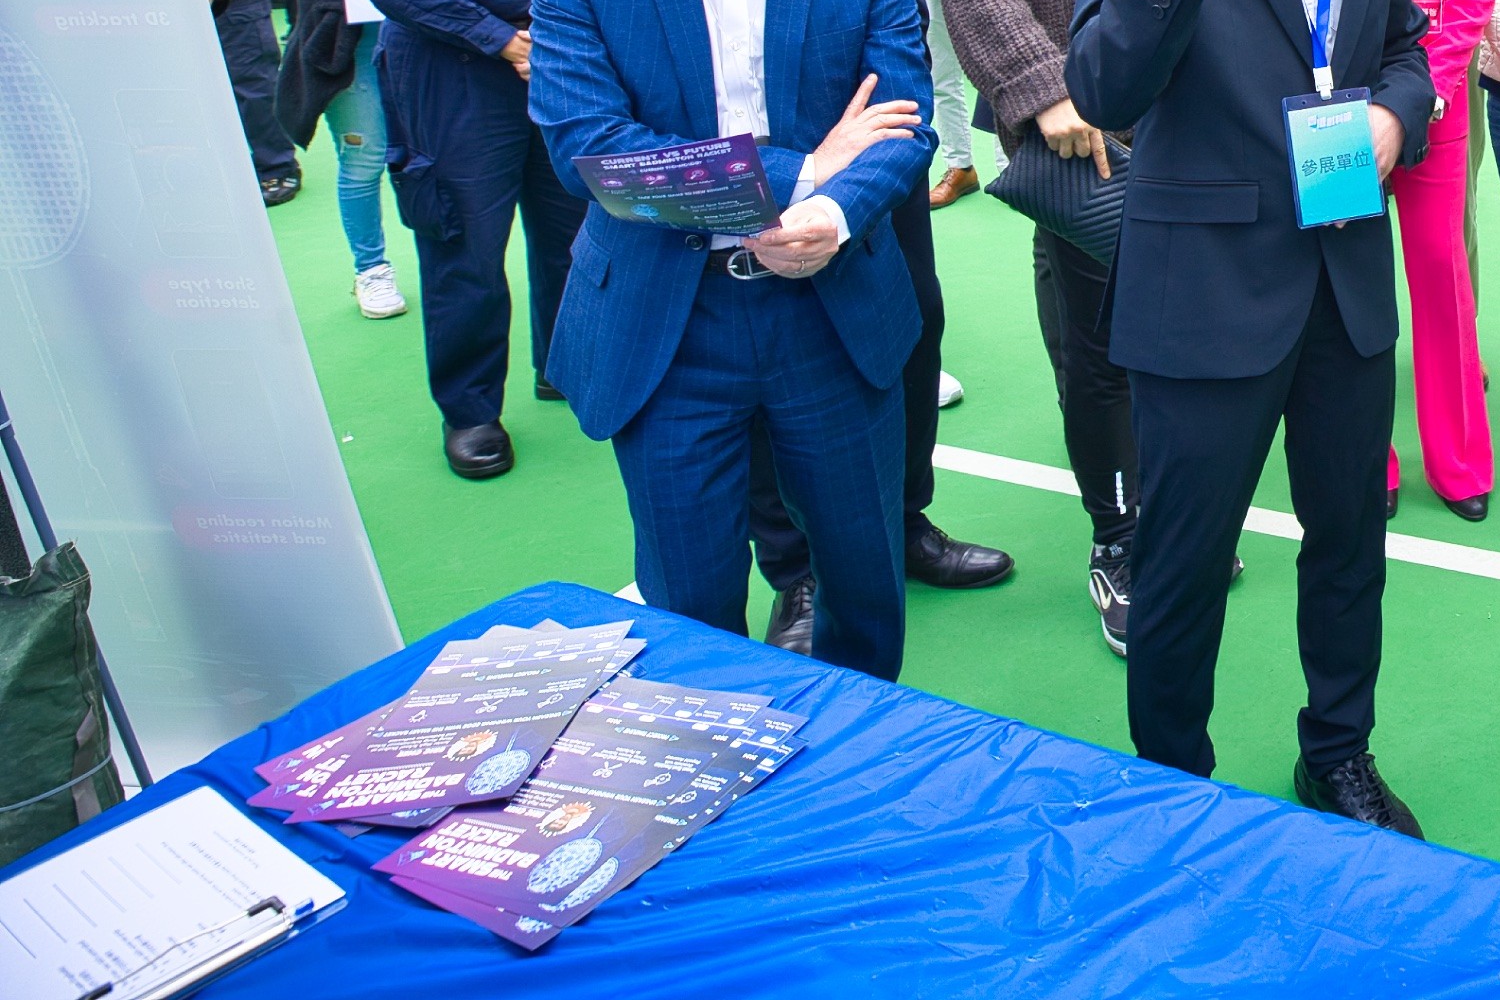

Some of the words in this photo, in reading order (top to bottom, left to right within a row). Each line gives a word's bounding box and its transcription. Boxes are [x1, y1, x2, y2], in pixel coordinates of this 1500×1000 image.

[600, 153, 658, 165] CURRENT
[663, 150, 681, 159] VS
[683, 141, 731, 155] FUTURE
[603, 162, 636, 170] SMART
[639, 155, 695, 167] BADMINTON
[696, 147, 733, 159] RACKET
[1301, 150, 1371, 177] 參展單位
[1111, 547, 1123, 558] AIR
[323, 773, 466, 800] BADMINTON
[335, 766, 432, 787] RACKET
[336, 788, 427, 809] SMART
[420, 789, 447, 800] THE
[437, 822, 520, 847] RACKET
[419, 834, 540, 869] BADMINTON
[420, 851, 499, 876] SMART
[489, 868, 513, 881] THE
